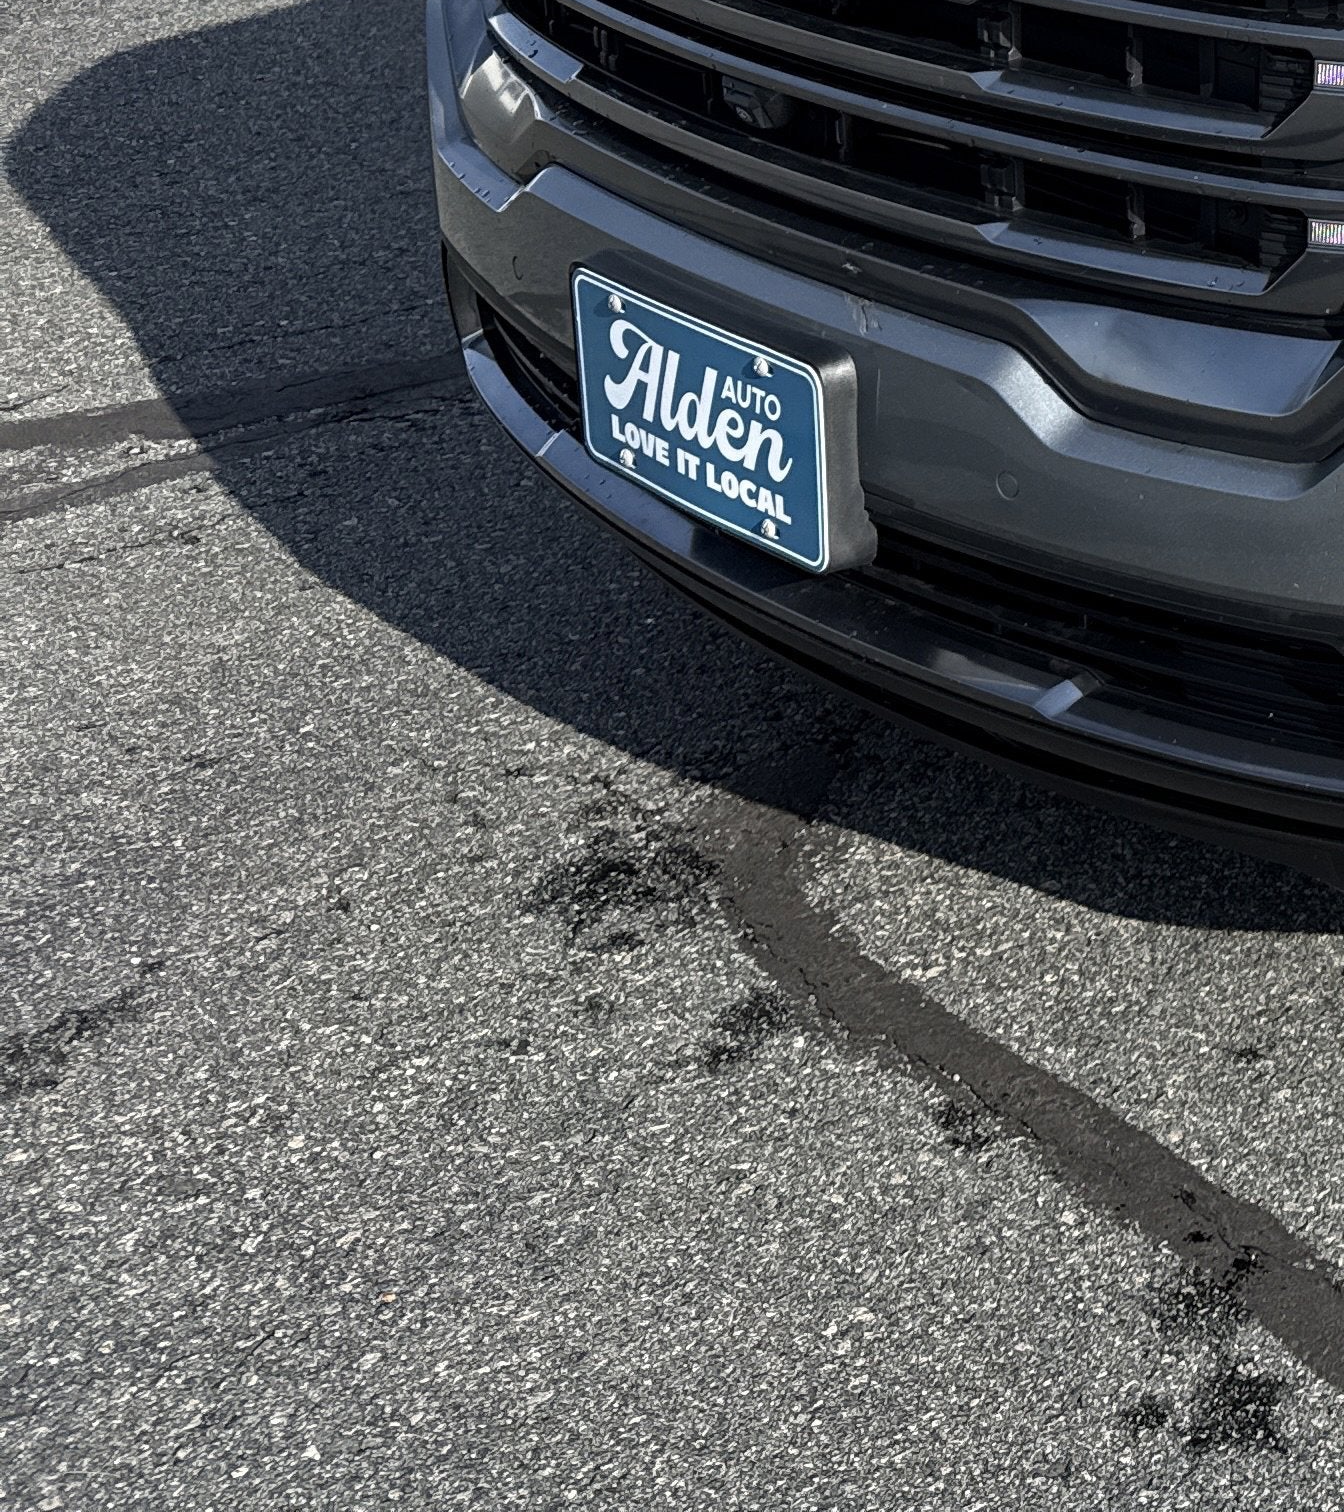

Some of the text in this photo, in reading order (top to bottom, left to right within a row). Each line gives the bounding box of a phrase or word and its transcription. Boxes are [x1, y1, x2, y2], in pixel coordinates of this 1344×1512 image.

[604, 319, 793, 482] Alden
[720, 375, 782, 421] AUTO
[611, 414, 792, 526] LOVE IT LOCAL
